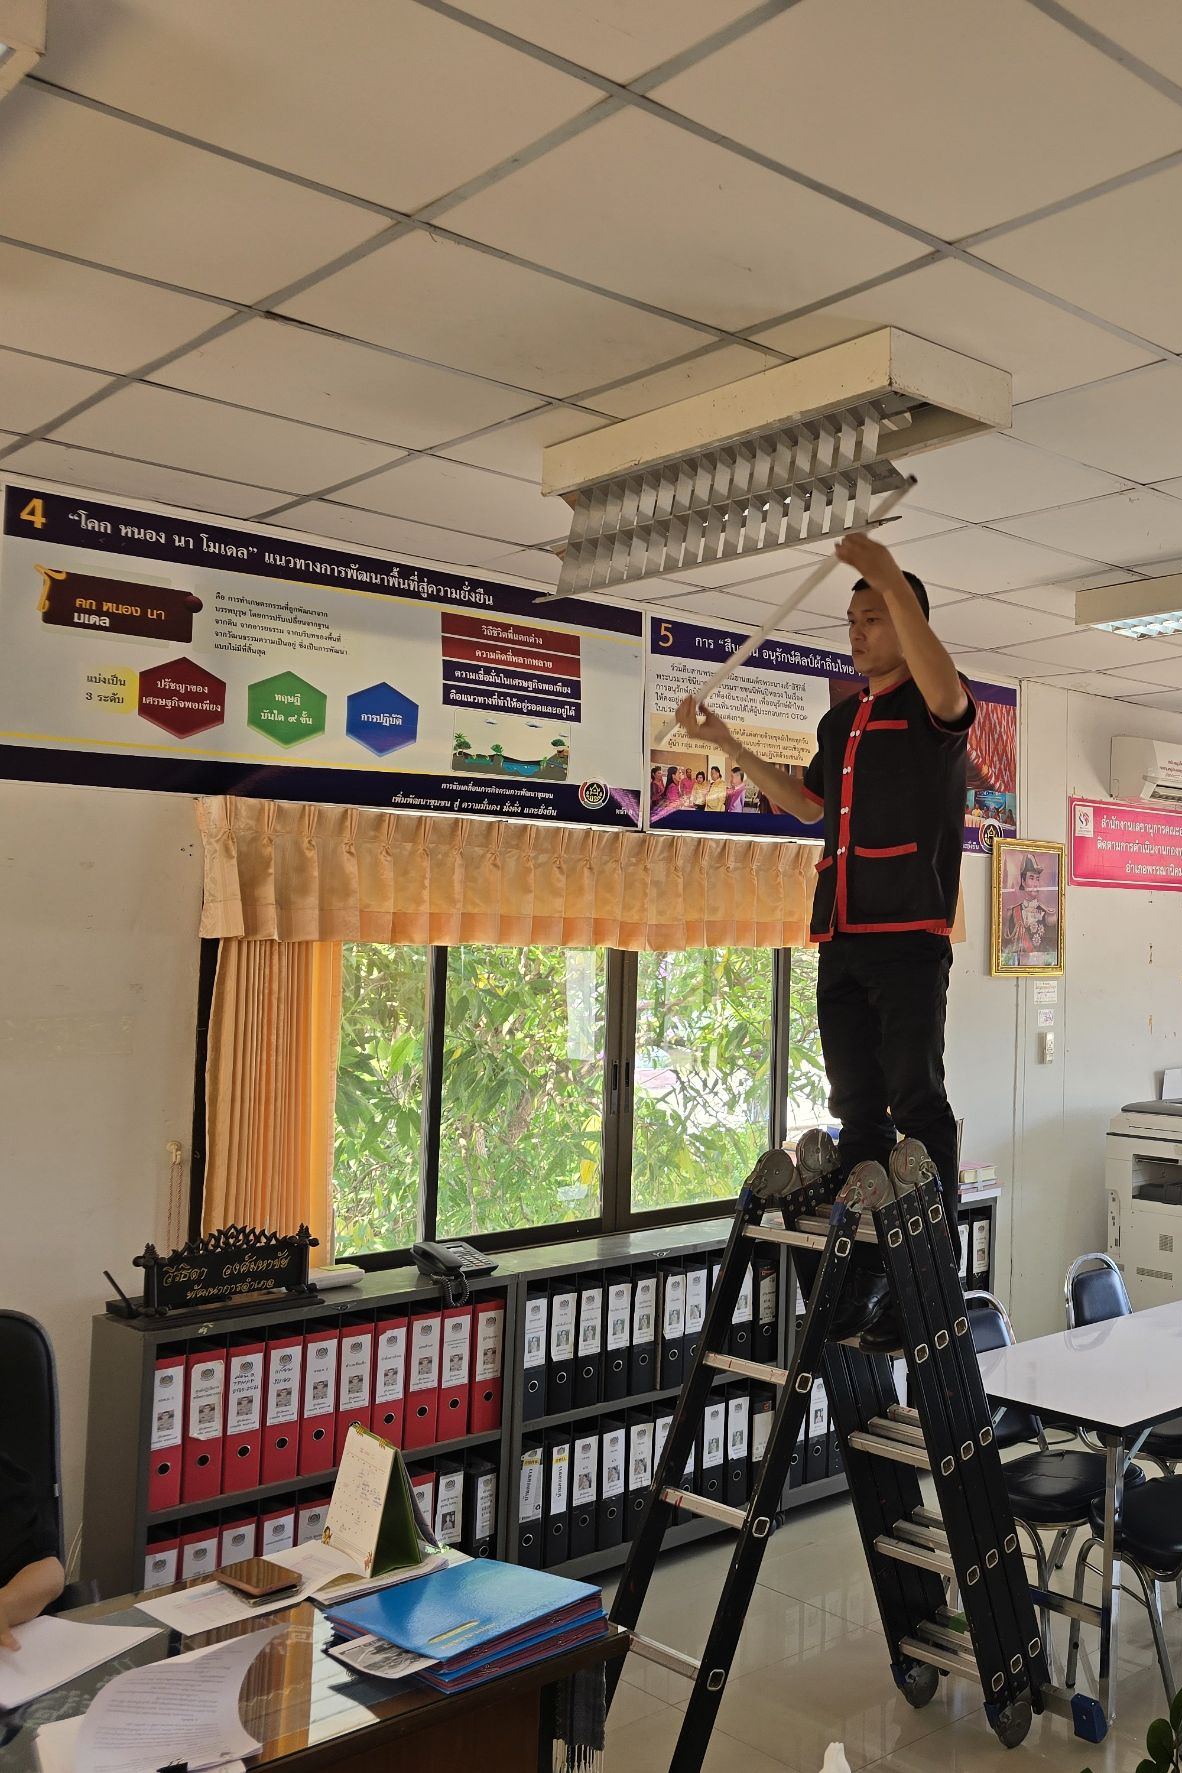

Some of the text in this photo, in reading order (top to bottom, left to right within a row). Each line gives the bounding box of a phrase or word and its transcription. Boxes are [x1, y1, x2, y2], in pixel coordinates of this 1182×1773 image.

[20, 498, 494, 606] 4 “โคก หนอง นา โมเดล” แนวทางการพัฒนาพื้นที่สู่ความยั่งยืน
[102, 600, 141, 617] หนอง
[147, 608, 165, 620] นา
[481, 625, 543, 646] วิถีชีวิตที่แตกต่าง
[659, 623, 674, 648] 5
[695, 636, 714, 649] การ
[475, 648, 553, 669] ความคิดที่หลากหลาย
[86, 673, 127, 687] แบ่งเป็น
[156, 678, 209, 694] ปรัชญาของ
[454, 668, 572, 695] ความเชื่อมั่นในเศรษฐกิจพอเพียง
[85, 691, 125, 705] 3 ระดับ
[142, 696, 222, 712] เศรษฐกิจพอเพียง
[274, 692, 302, 706] ทฤษฎี
[449, 690, 576, 719] คือแนวทางที่ทำให้อยู่รอดและอยู่ได้
[260, 710, 285, 722] บันได
[300, 711, 313, 725] ขั้น
[360, 710, 403, 727] การปฏิบัติ
[186, 1278, 275, 1299] พัฒนาการอำเภอ
